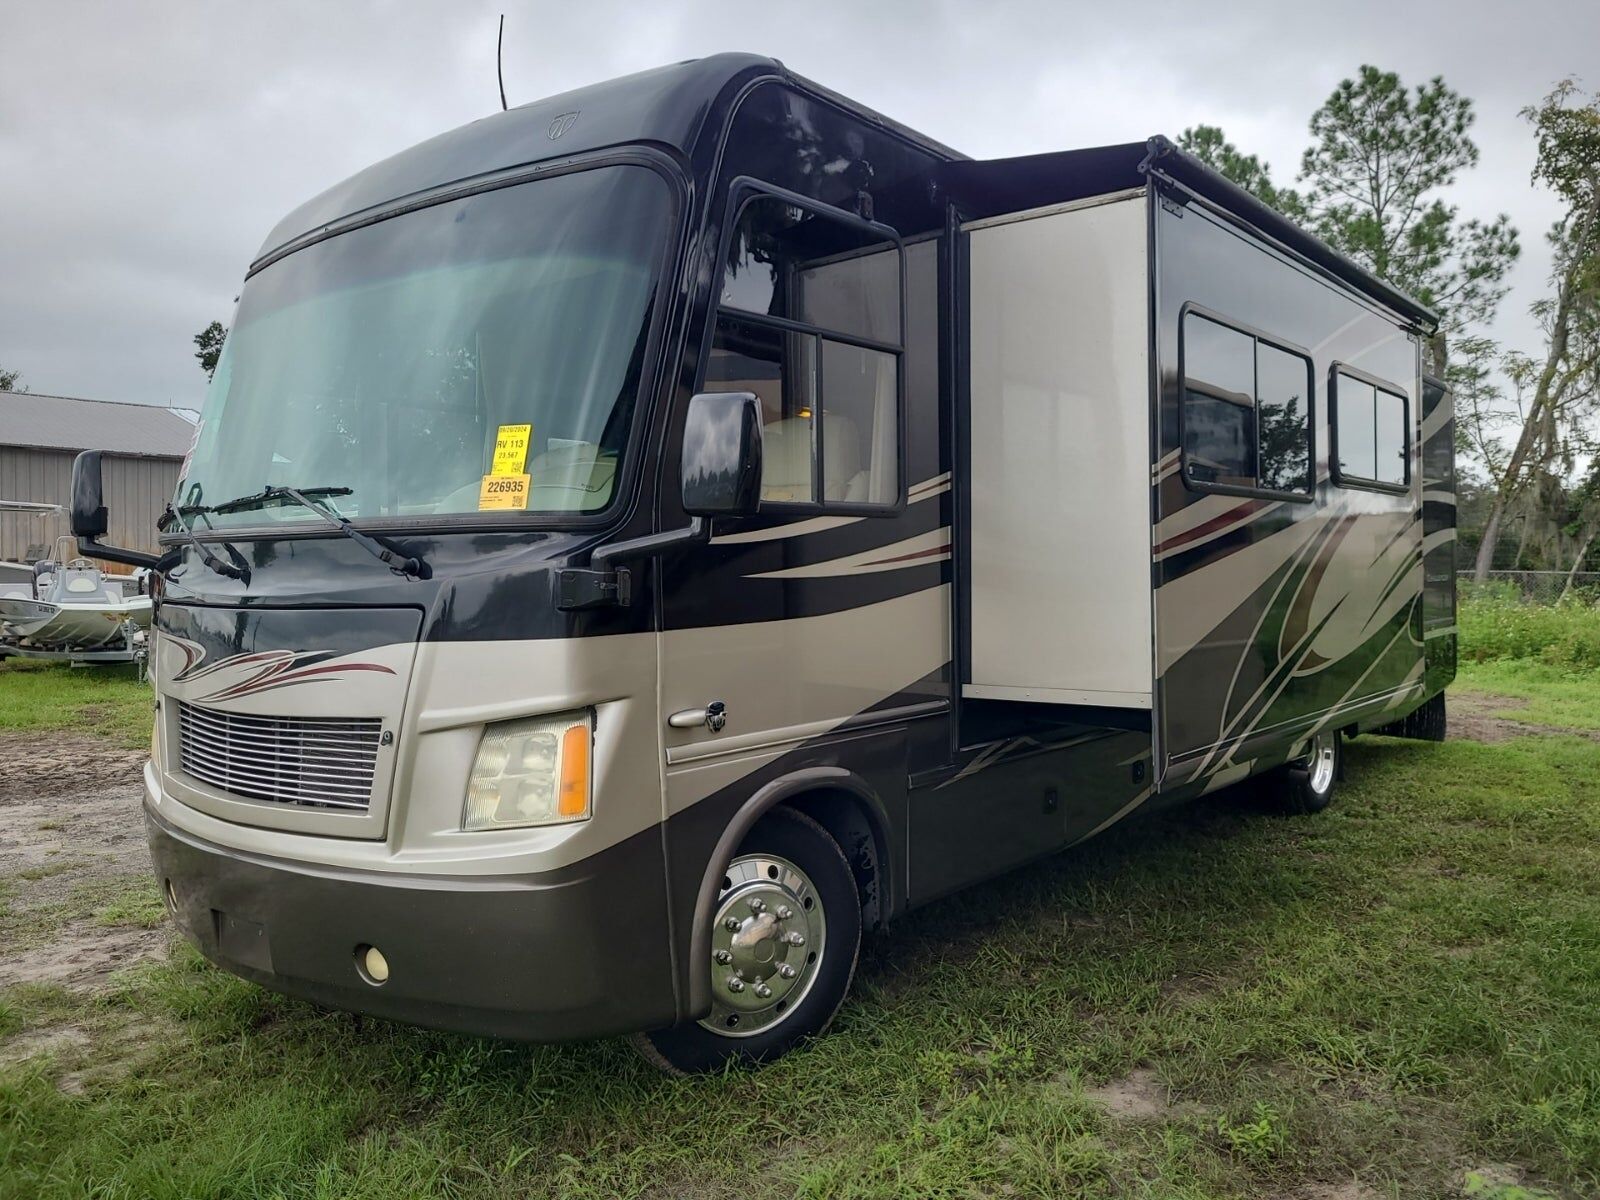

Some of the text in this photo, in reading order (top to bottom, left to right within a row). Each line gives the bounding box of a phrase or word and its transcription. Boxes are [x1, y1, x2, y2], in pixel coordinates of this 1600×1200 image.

[497, 439, 524, 449] RV 113
[488, 481, 524, 493] 226935
